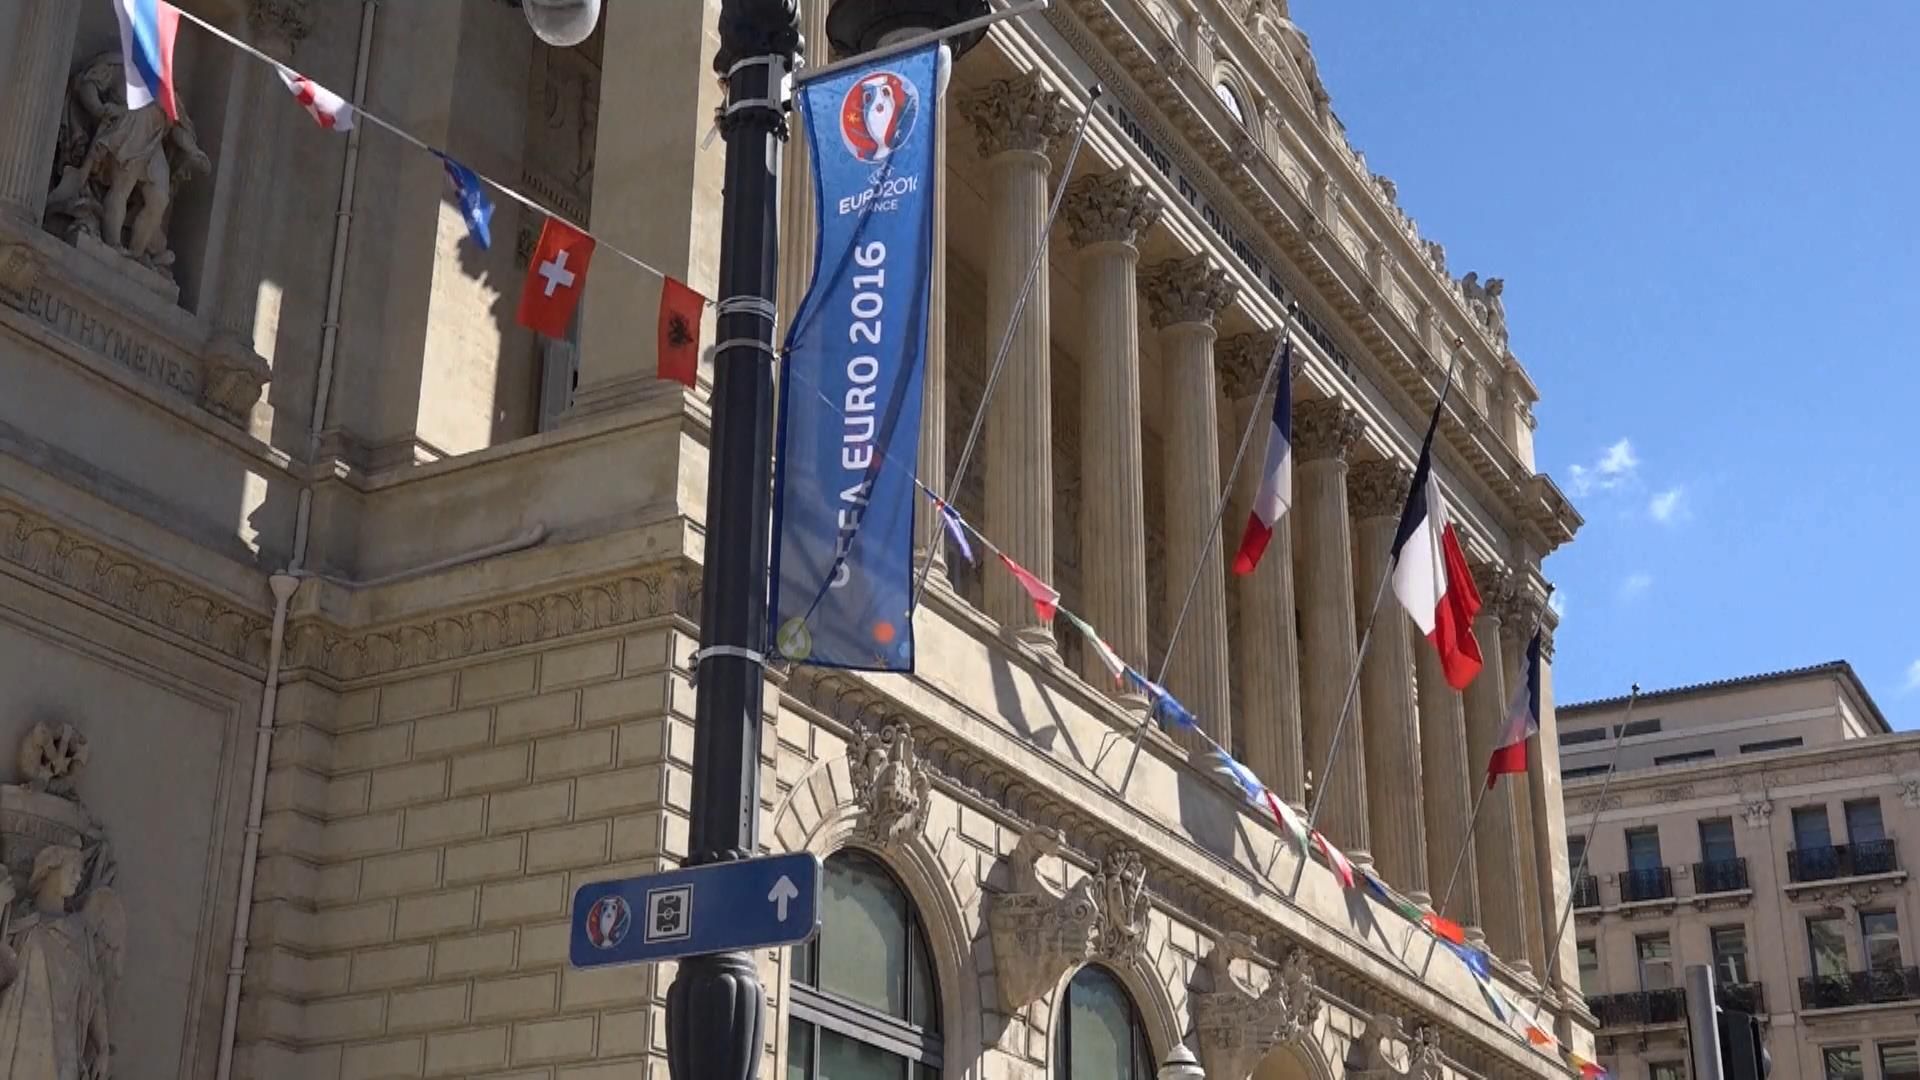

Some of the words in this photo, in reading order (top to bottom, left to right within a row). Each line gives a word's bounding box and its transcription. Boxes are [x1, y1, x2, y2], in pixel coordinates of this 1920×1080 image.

[849, 241, 886, 344] 2016
[1179, 175, 1197, 206] ET
[1296, 308, 1349, 376] OMMERCE
[27, 286, 195, 396] EUTHYMENES
[842, 355, 879, 470] EURO
